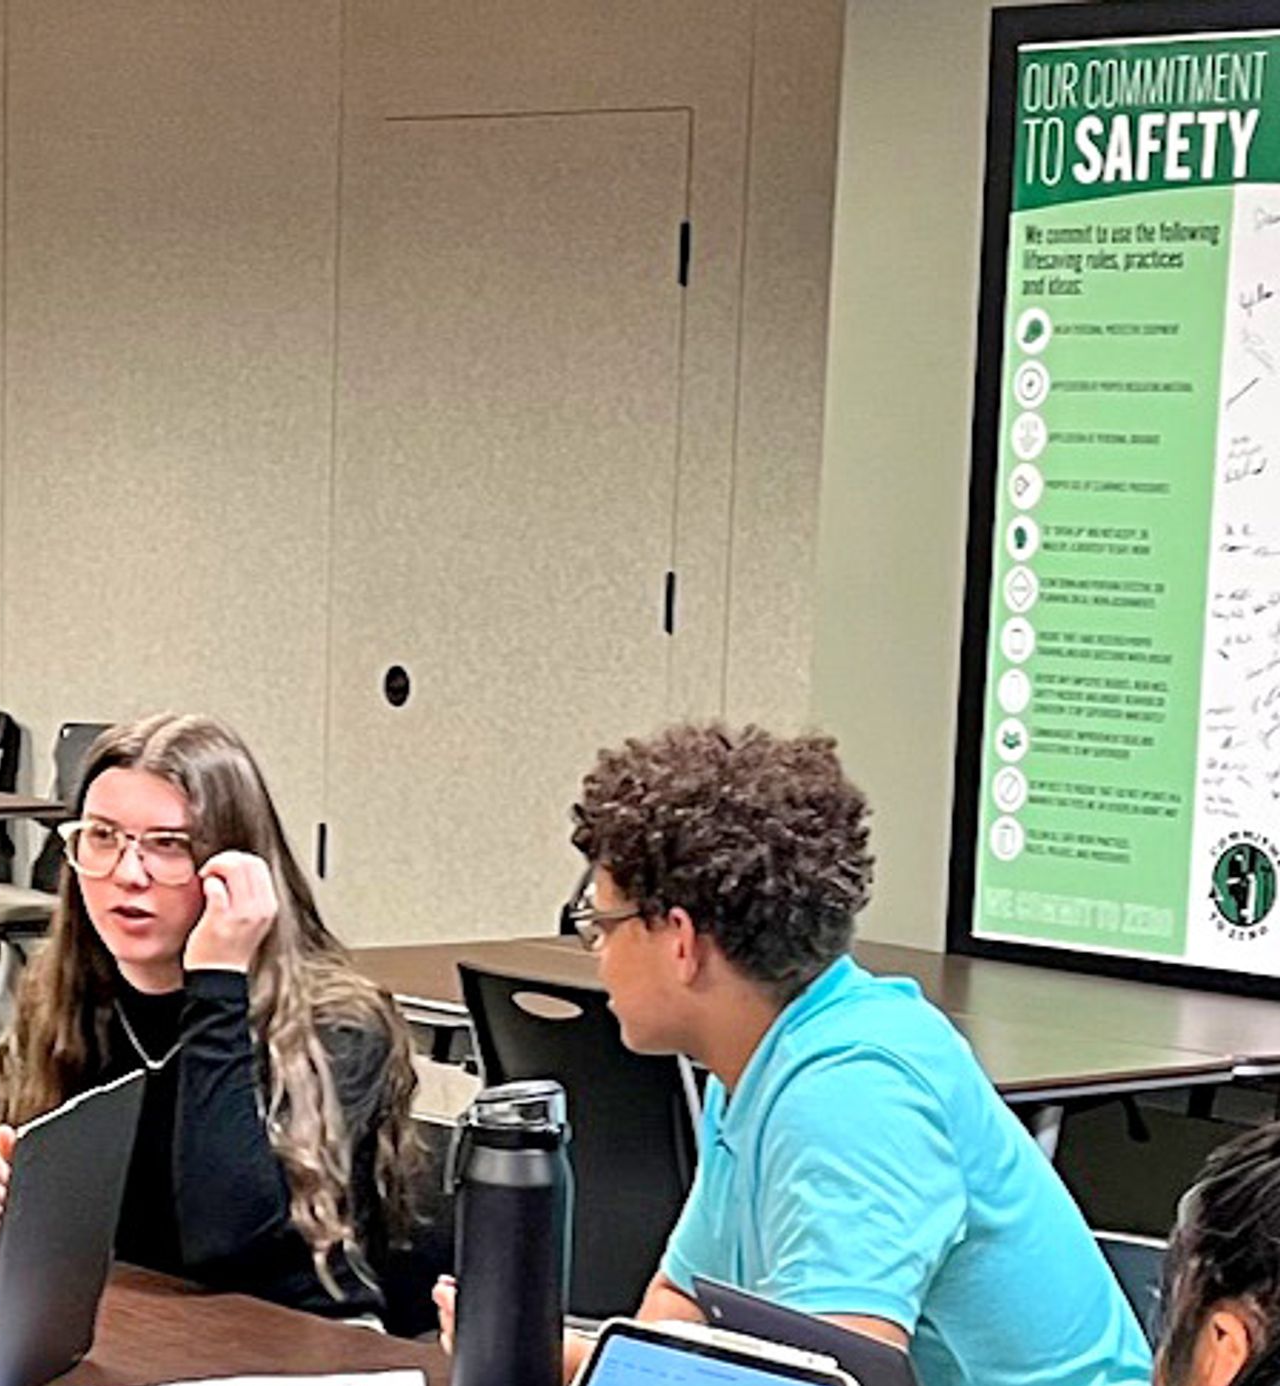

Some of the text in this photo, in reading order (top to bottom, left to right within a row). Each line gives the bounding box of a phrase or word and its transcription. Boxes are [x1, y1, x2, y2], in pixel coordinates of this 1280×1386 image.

[1022, 51, 1268, 112] OUR COMMITMENT
[1023, 108, 1260, 186] TO SAFETY
[1025, 222, 1220, 246] We commit to use the following
[1023, 250, 1082, 273] lifesaving
[1123, 251, 1183, 272] practices
[1023, 276, 1044, 295] and
